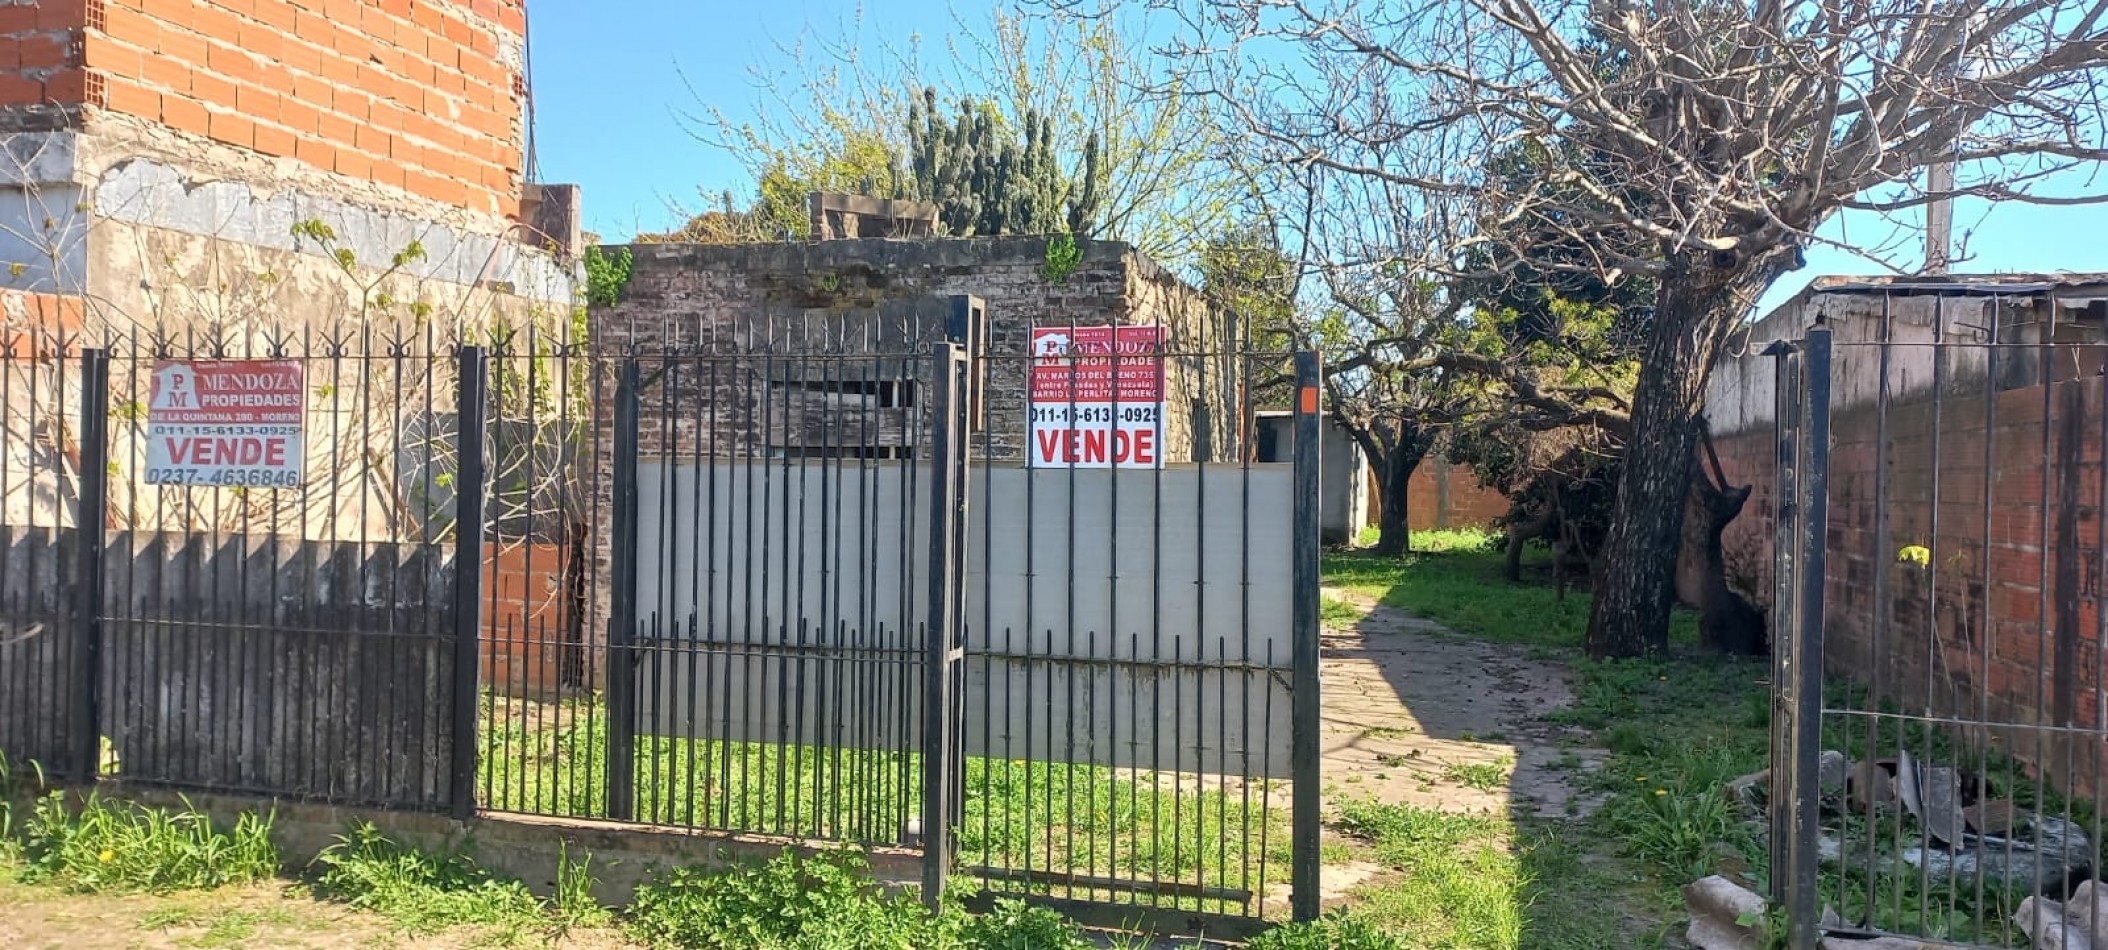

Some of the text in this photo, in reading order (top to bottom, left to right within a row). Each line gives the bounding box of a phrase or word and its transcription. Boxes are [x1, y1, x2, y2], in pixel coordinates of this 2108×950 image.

[1046, 341, 1058, 353] P
[1074, 356, 1156, 366] PROPIDADE
[172, 373, 184, 390] P
[202, 373, 300, 391] MENDOZA
[1036, 372, 1050, 380] AV.
[1051, 371, 1086, 380] MAROS
[1087, 371, 1104, 379] DEL
[1105, 371, 1136, 379] BENO
[1063, 381, 1098, 389] Psadas
[1105, 380, 1154, 390] Vnezuela)
[168, 392, 188, 407] M
[202, 394, 300, 407] PROPIEDADES
[149, 413, 164, 422] DE
[168, 413, 180, 422] LA
[183, 413, 233, 422] QUINTANA
[261, 412, 300, 421] MORENO
[154, 425, 298, 436] 011-15-6133-0925
[165, 437, 286, 465] VENDE
[1037, 429, 1154, 463] VENDE
[148, 468, 297, 486] 0237- 4636846
